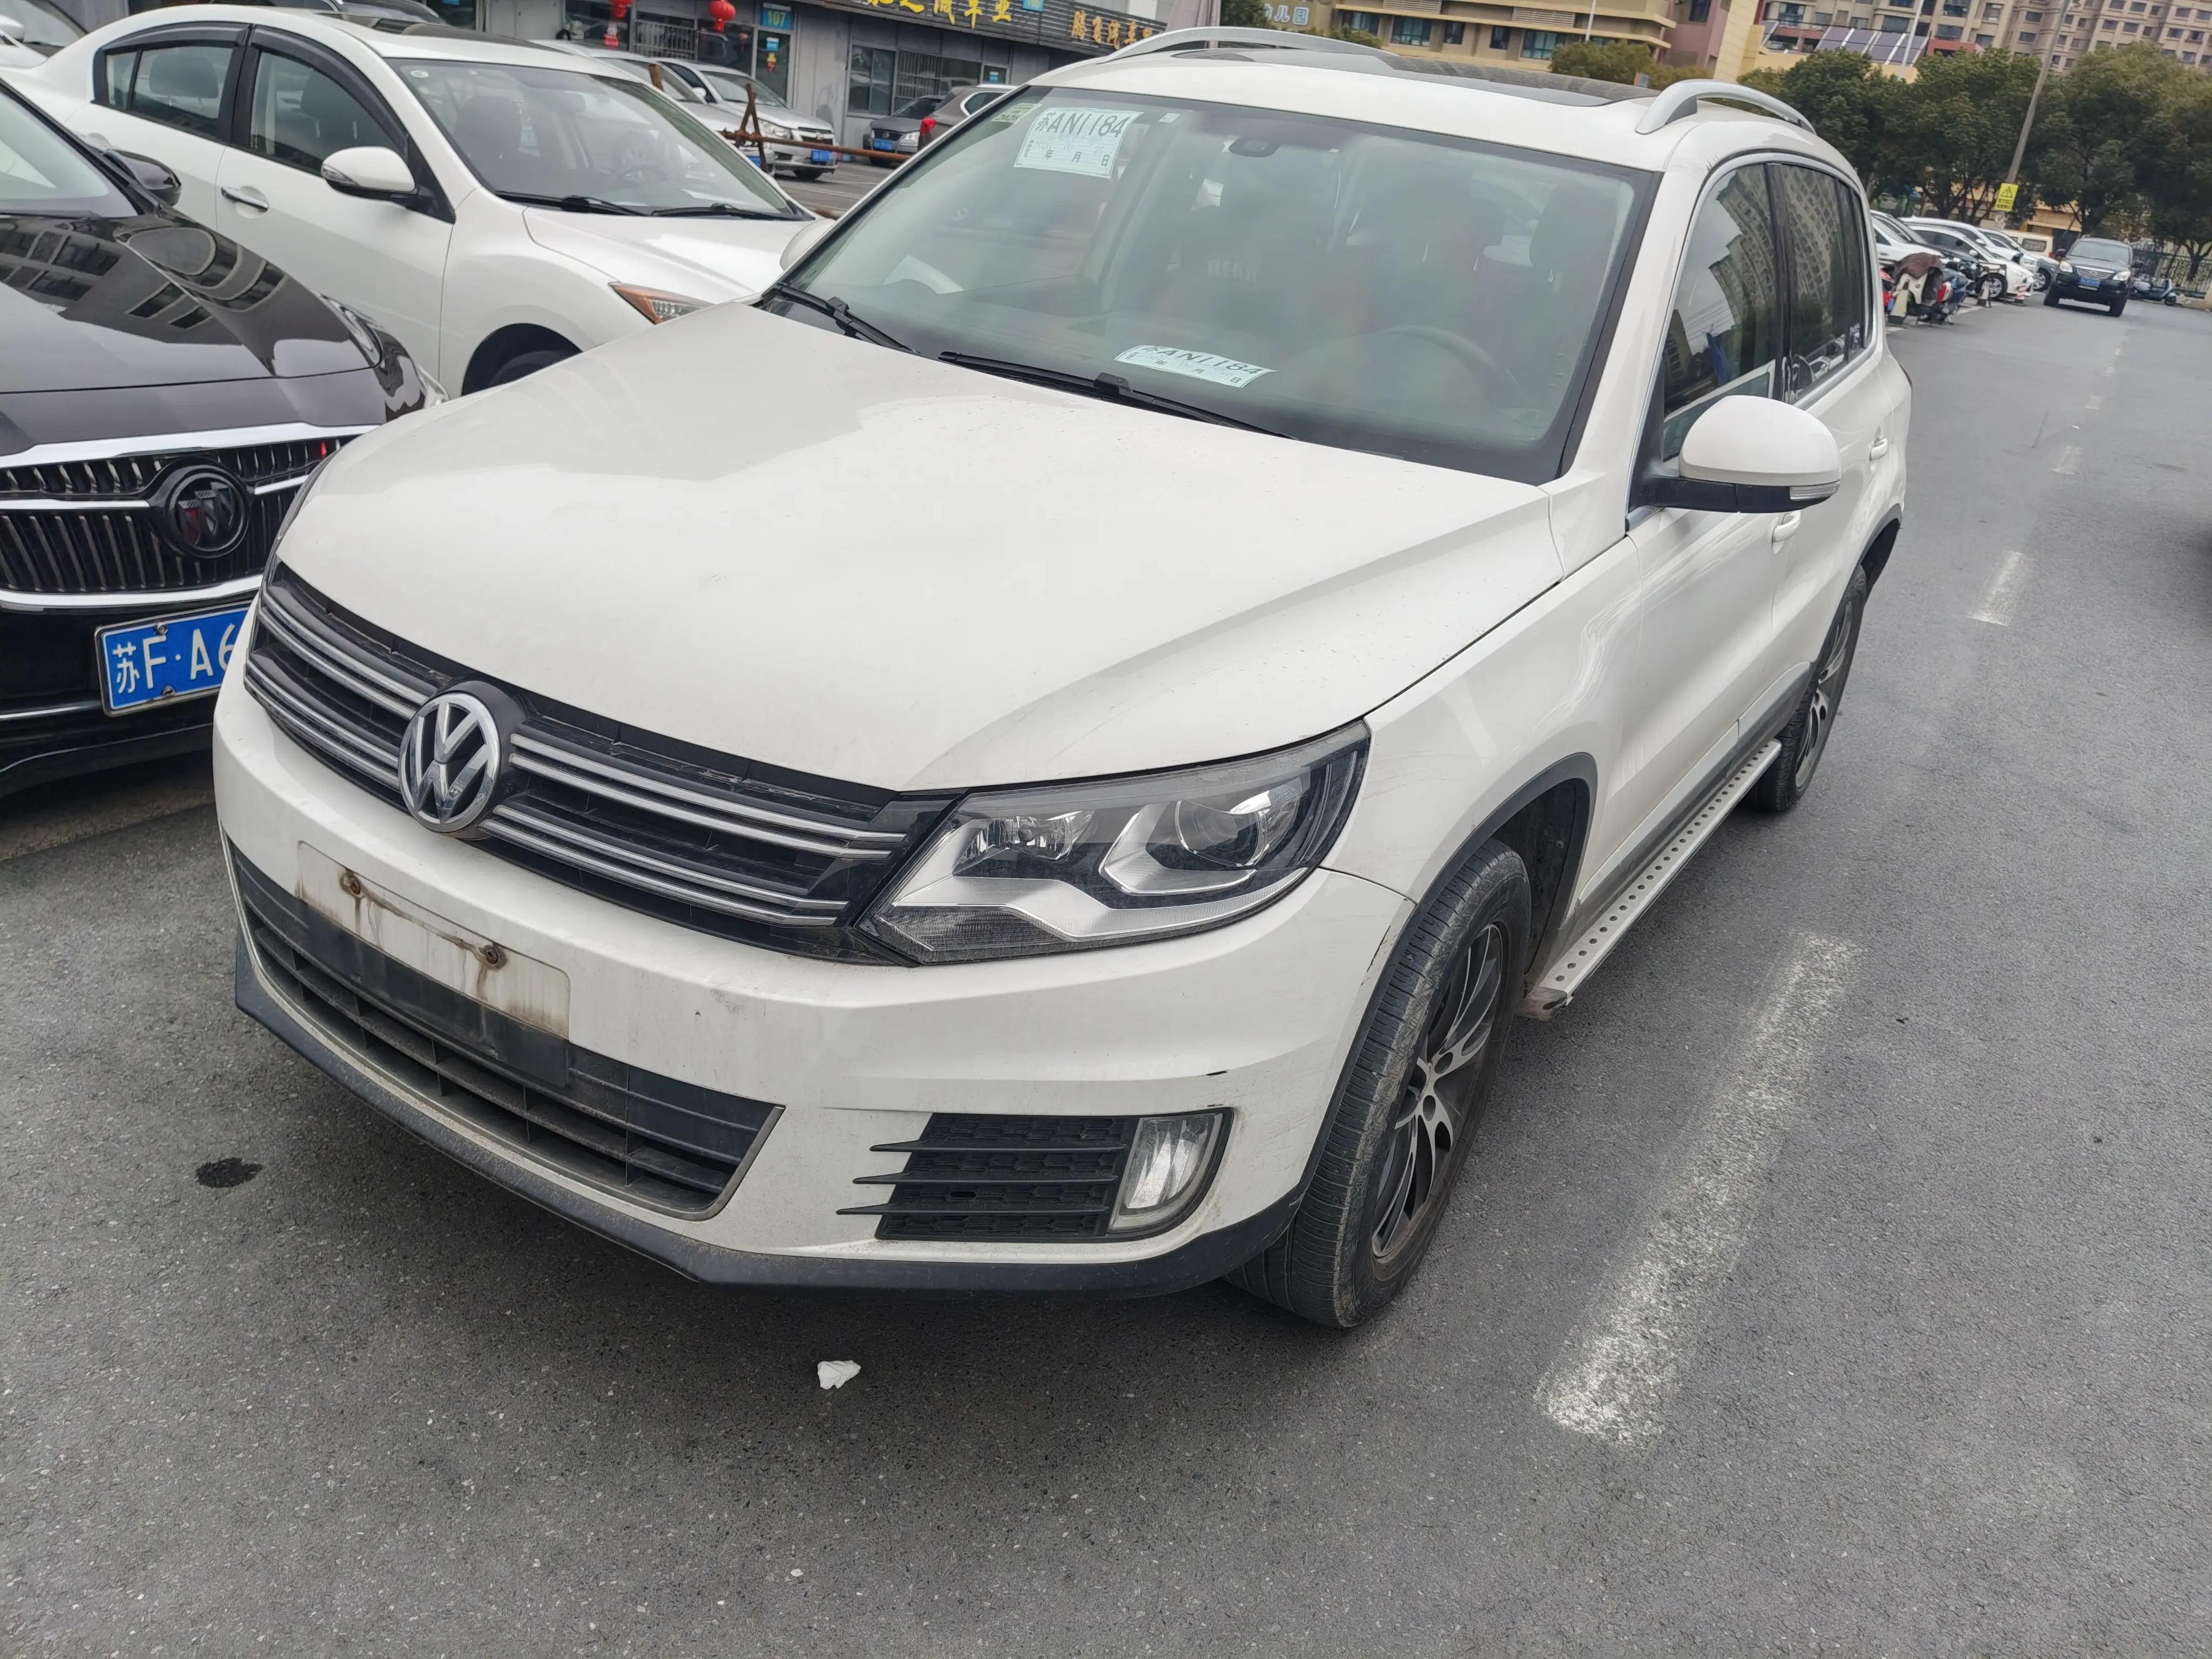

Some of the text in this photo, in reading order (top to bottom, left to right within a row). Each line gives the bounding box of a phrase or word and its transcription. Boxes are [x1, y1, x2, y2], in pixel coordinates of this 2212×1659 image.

[768, 11, 786, 26] 107
[1035, 112, 1130, 138] 苏AN1184
[1071, 152, 1082, 163] 月
[1101, 154, 1110, 167] 日
